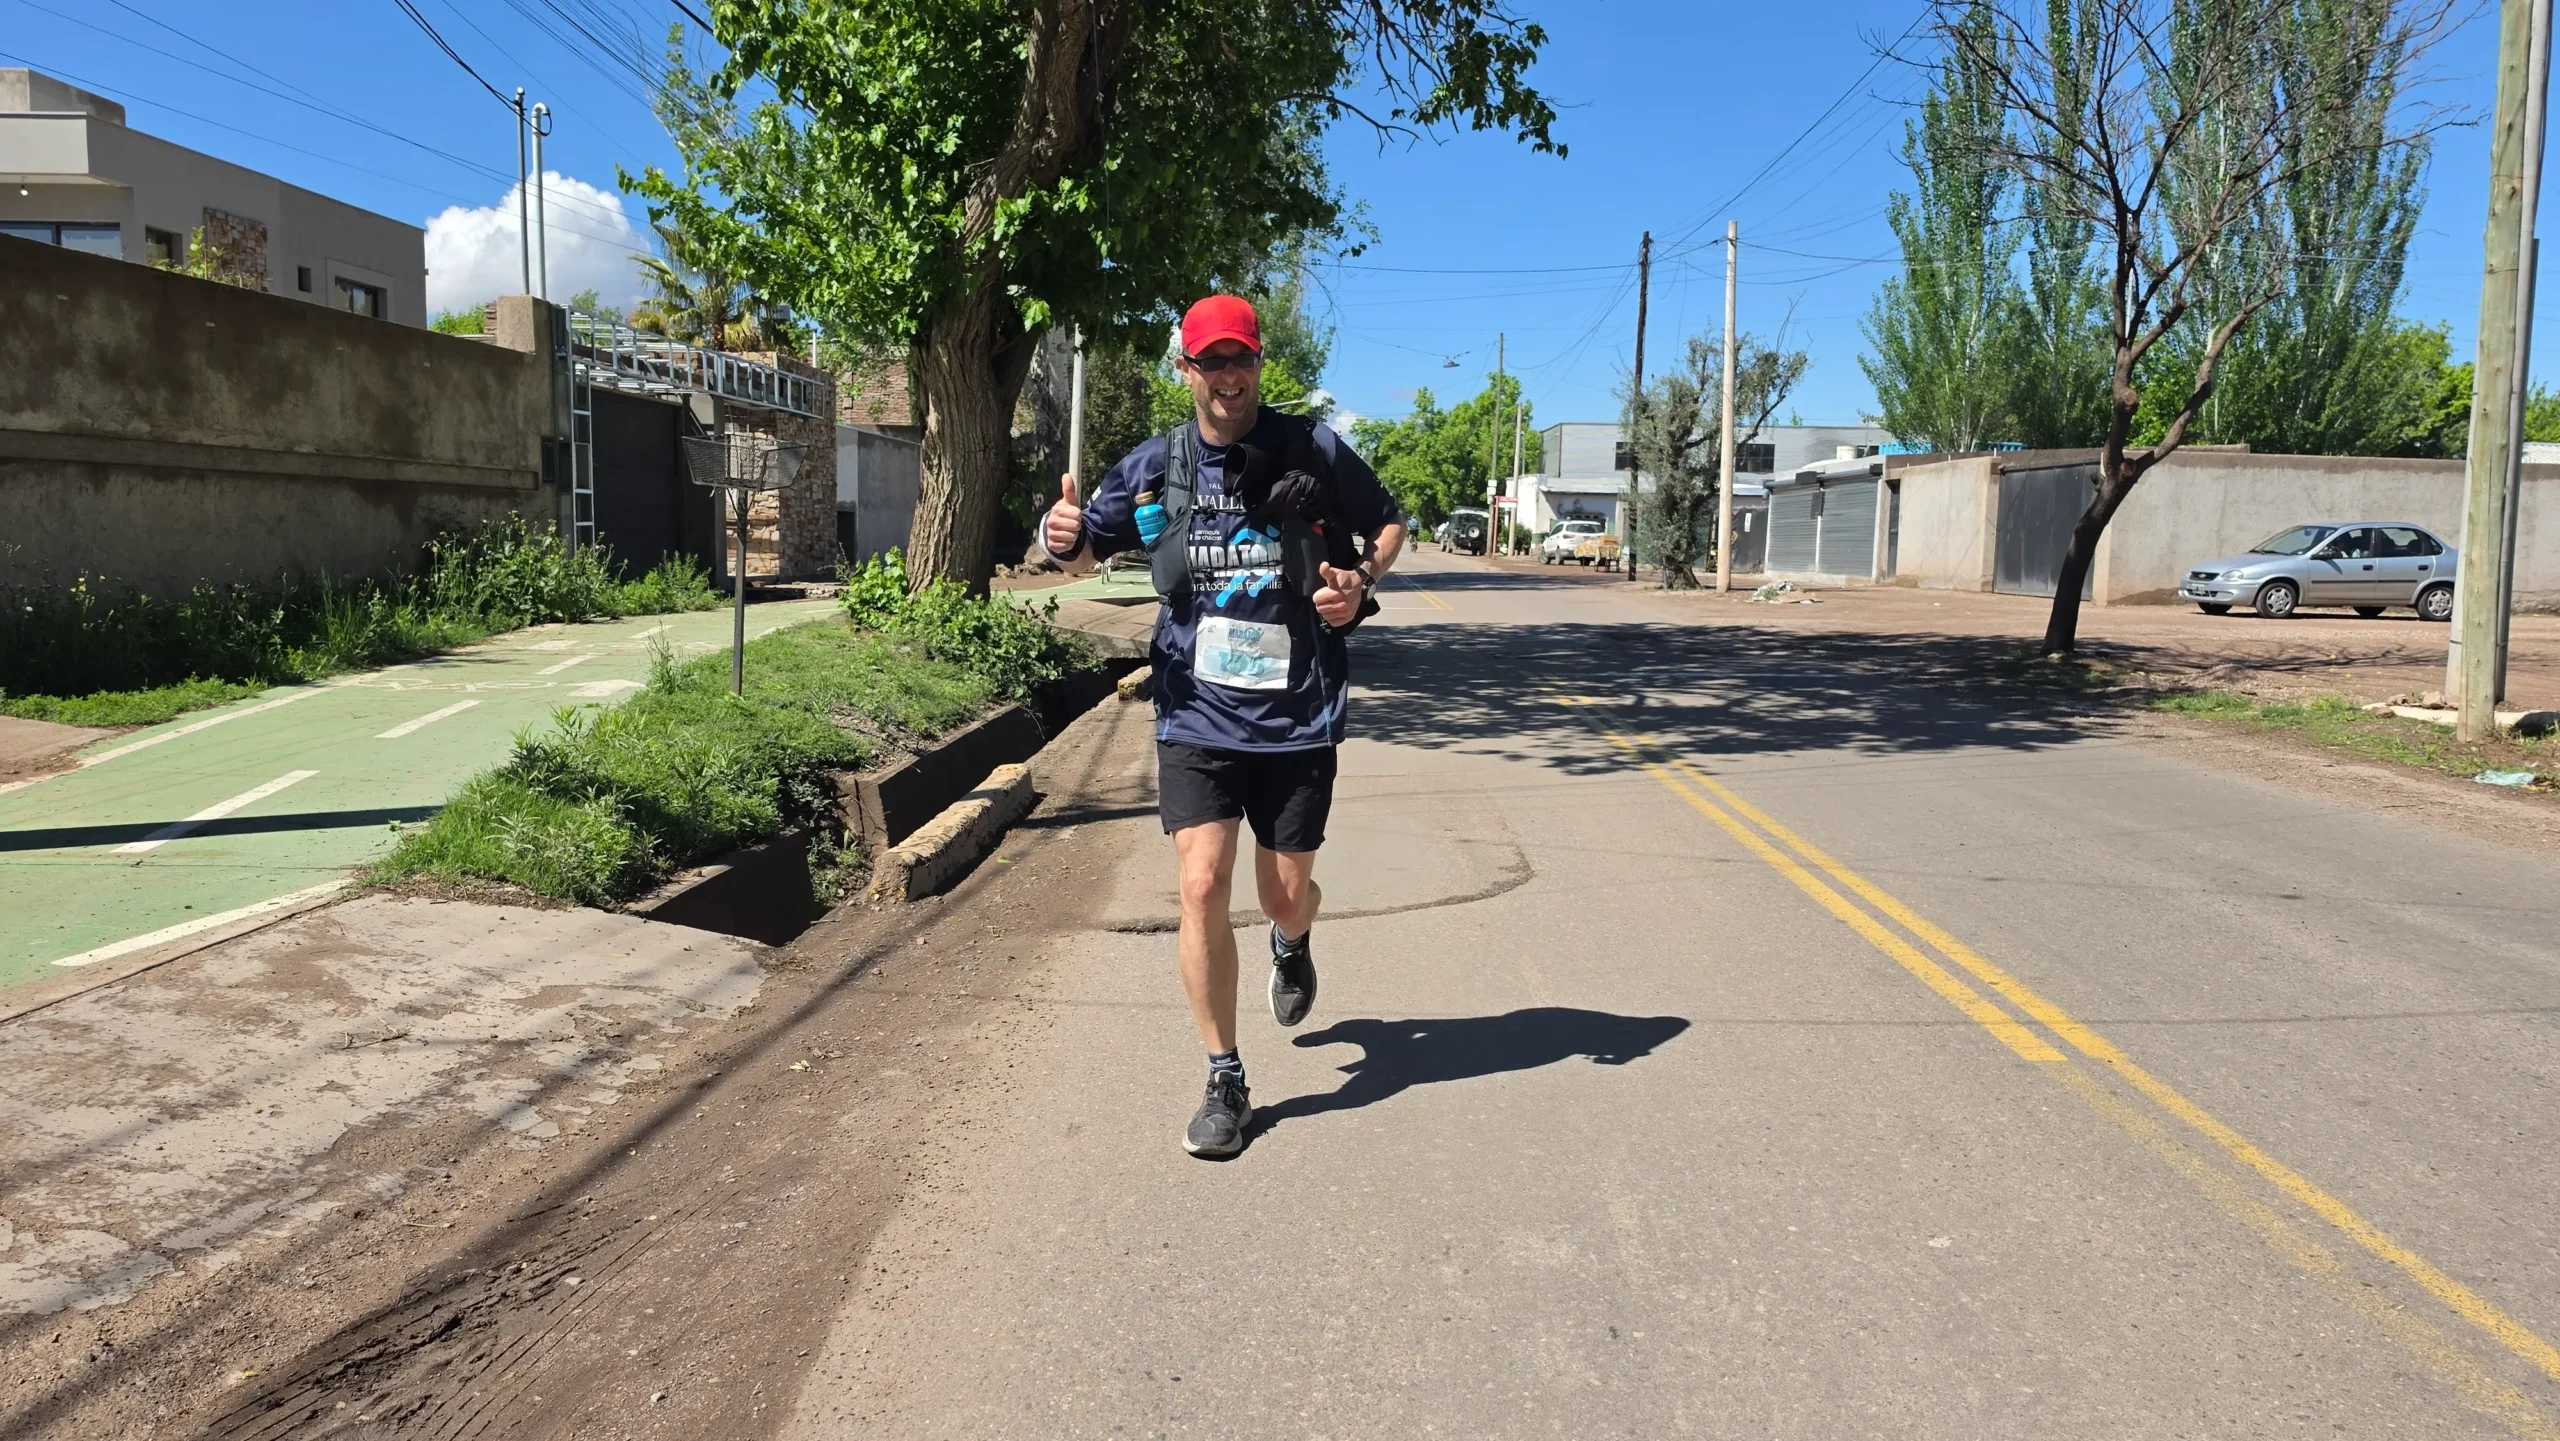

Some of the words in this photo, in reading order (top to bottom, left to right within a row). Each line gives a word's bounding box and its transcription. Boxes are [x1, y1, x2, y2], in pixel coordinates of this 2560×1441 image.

[1197, 494, 1245, 510] VALL
[1193, 583, 1205, 591] ara
[1206, 581, 1230, 591] toda
[1246, 580, 1283, 591] familia
